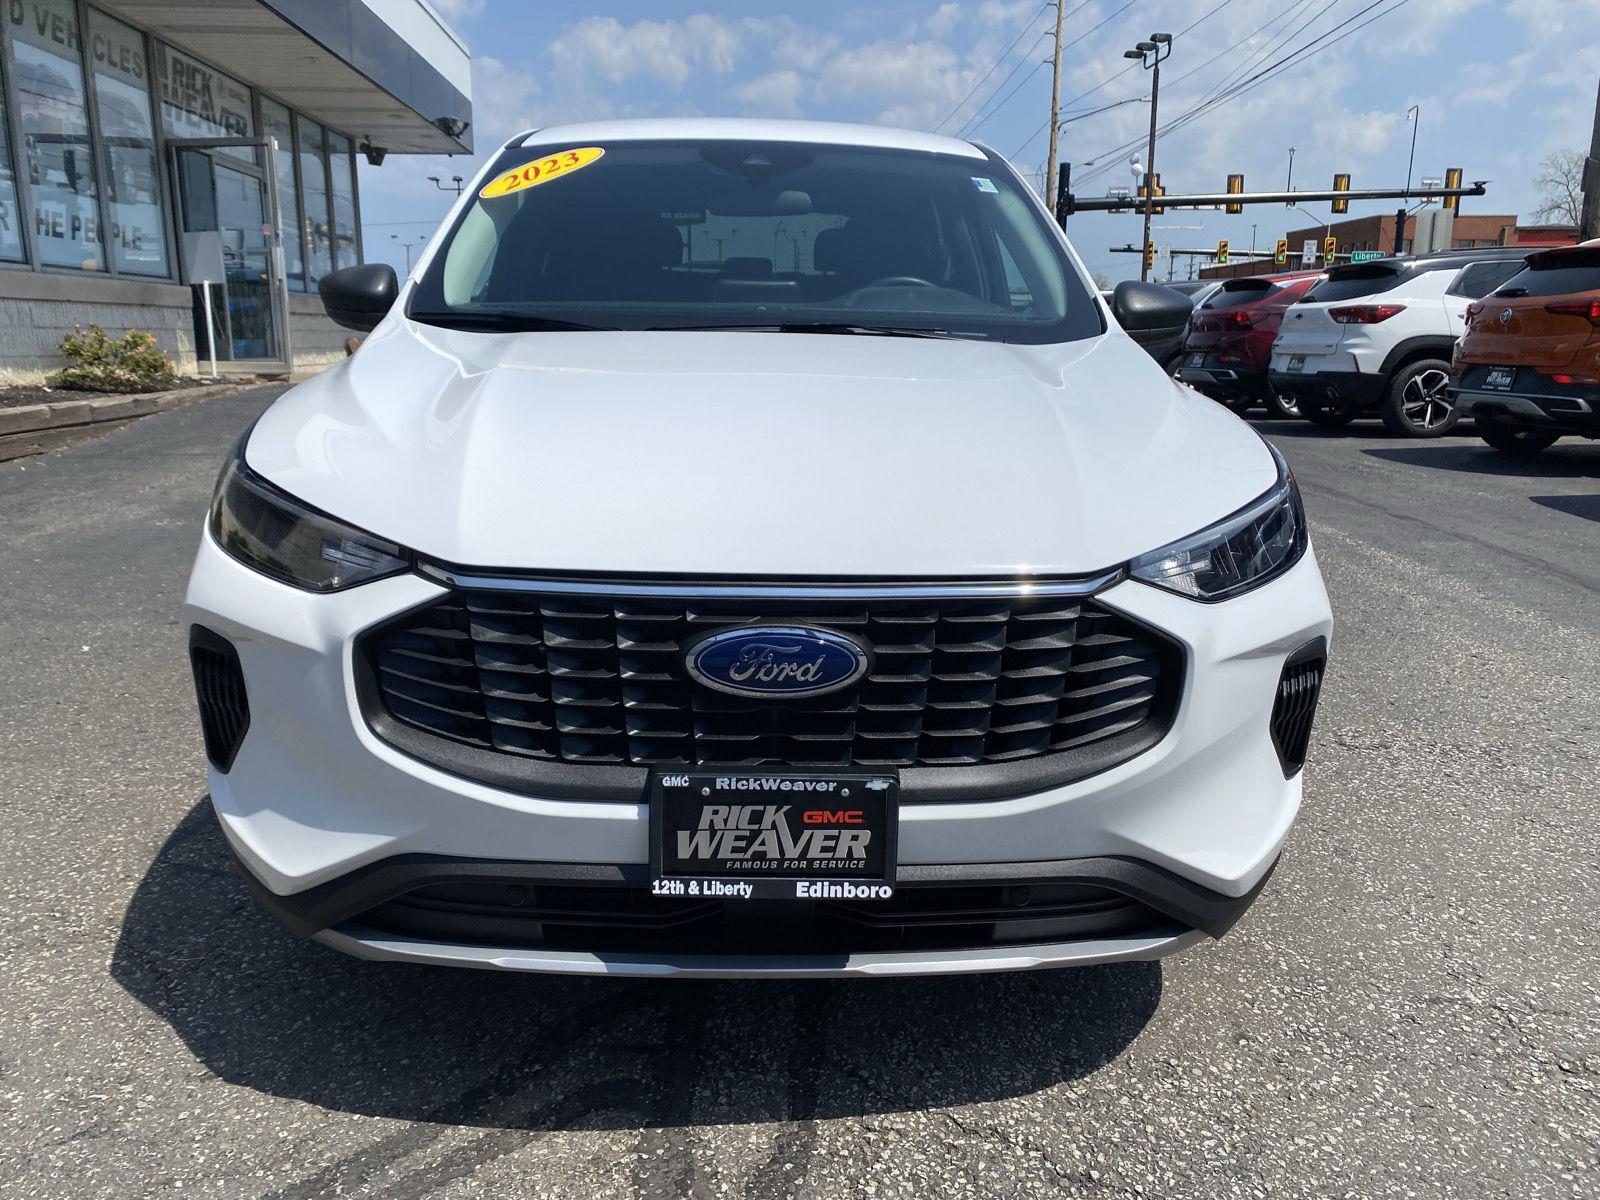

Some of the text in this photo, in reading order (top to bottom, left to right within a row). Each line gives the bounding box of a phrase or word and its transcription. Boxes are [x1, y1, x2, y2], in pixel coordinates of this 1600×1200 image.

[32, 3, 144, 79] VEHCLES
[503, 152, 580, 192] 2023
[35, 207, 64, 239] HE
[729, 643, 826, 682] Ford
[662, 775, 690, 787] GMC
[715, 777, 838, 792] RickWeaver
[698, 805, 793, 831] RICK
[803, 810, 865, 824] GMC
[676, 829, 872, 859] WEAVER
[726, 860, 866, 869] FAMOUS FOR SERVICE
[651, 880, 753, 899] 12th & Liberty
[796, 881, 893, 898] Edinboro
